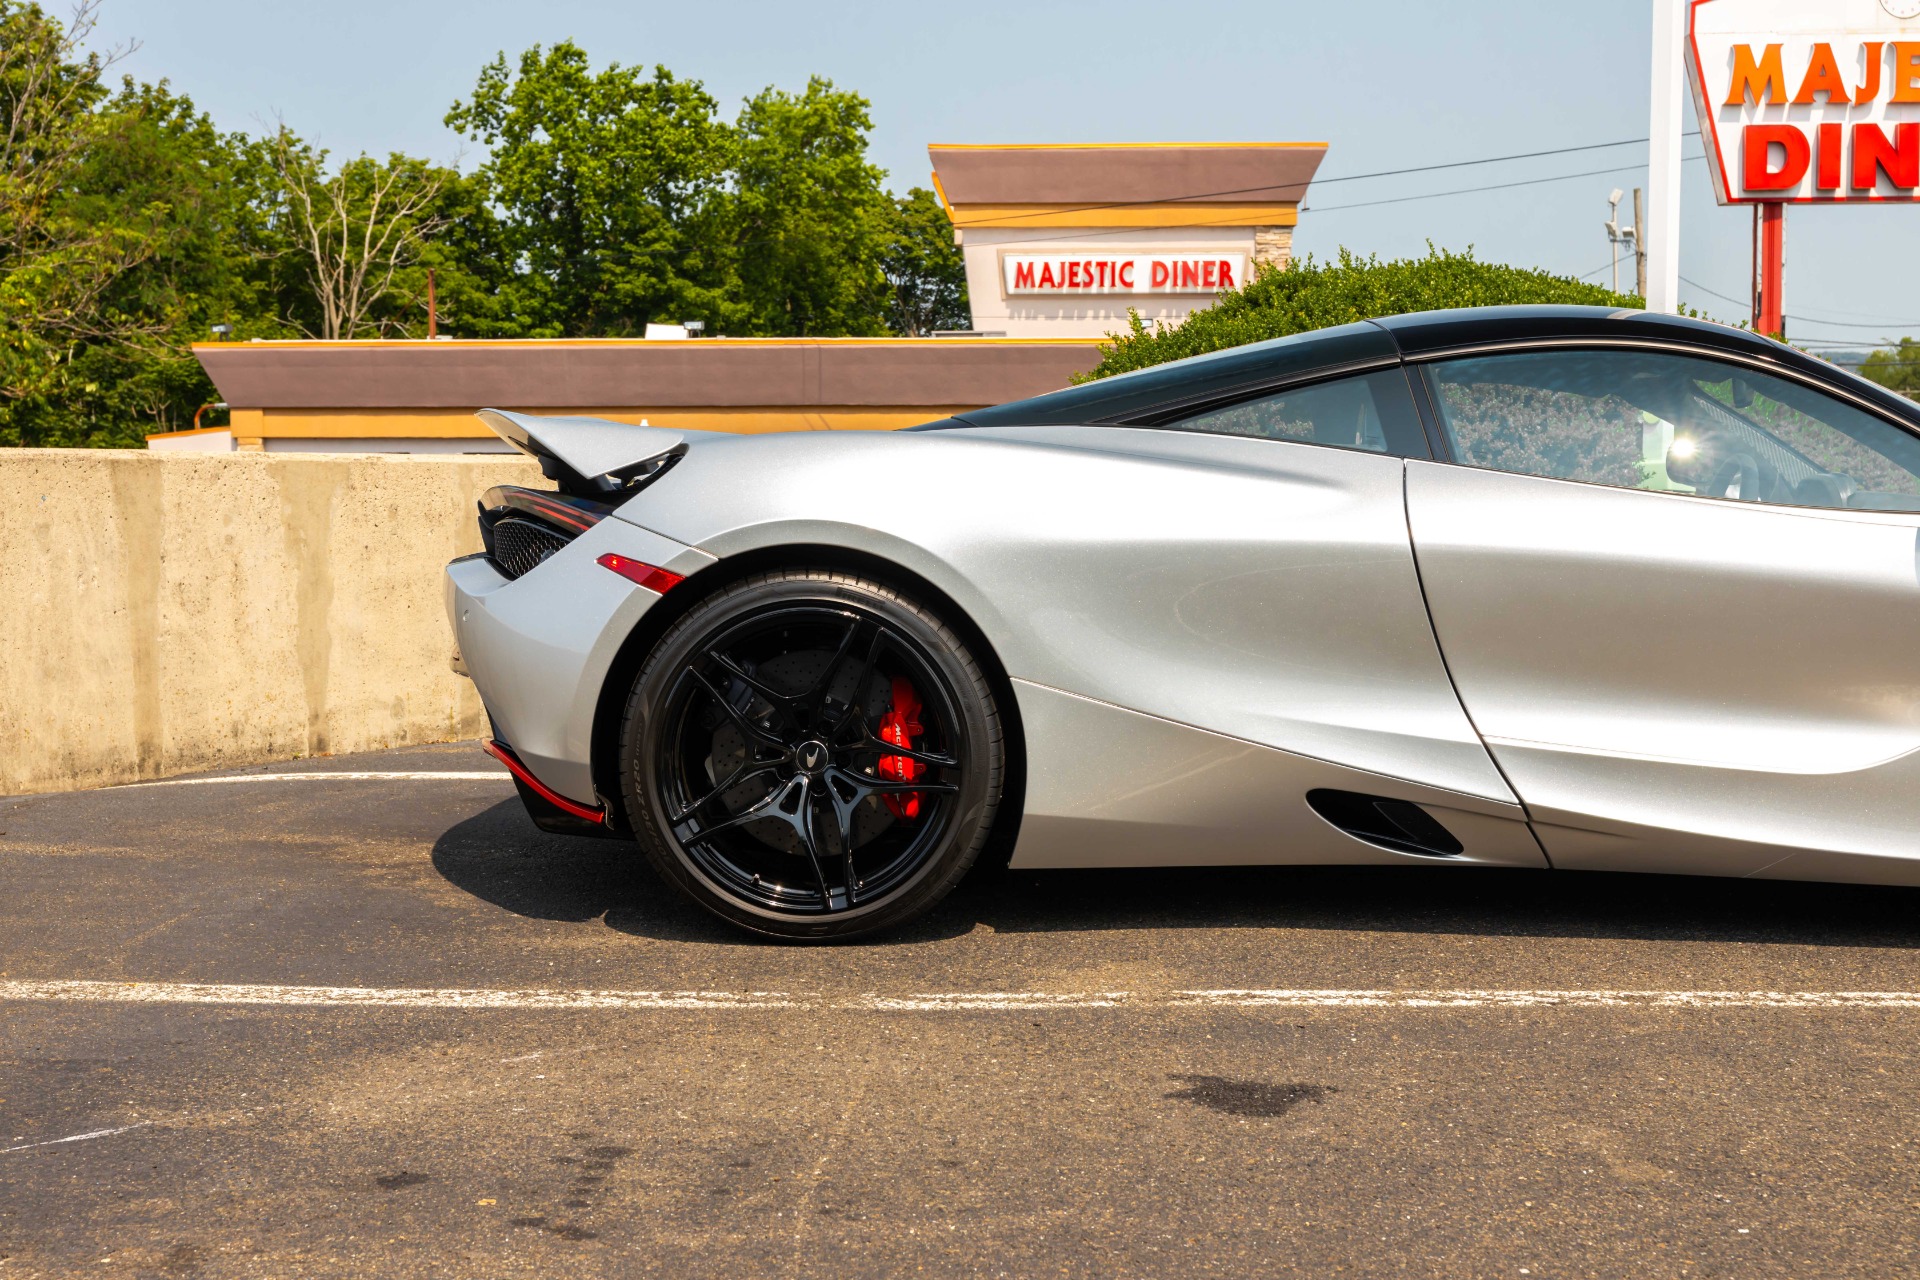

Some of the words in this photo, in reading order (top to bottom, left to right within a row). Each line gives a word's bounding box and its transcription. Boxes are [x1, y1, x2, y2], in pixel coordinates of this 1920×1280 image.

[1723, 41, 1920, 107] MAJE
[1743, 123, 1920, 190] DIN
[1014, 260, 1134, 288] MAJESTIC
[1151, 260, 1235, 288] DINER
